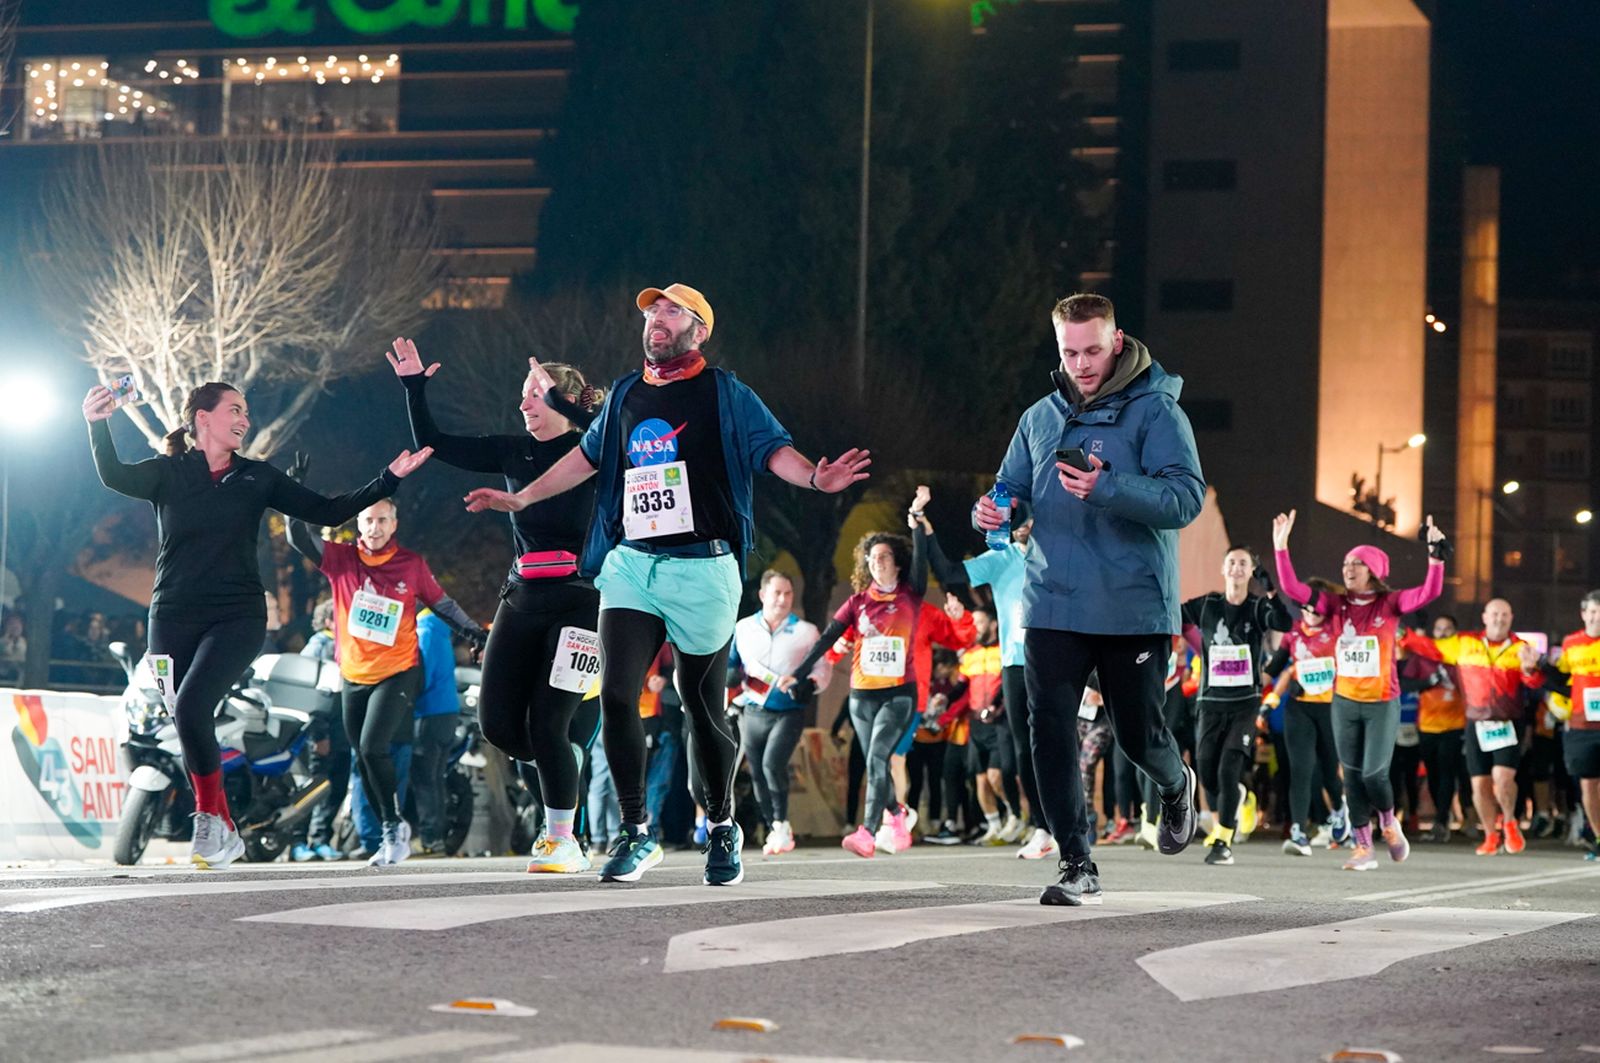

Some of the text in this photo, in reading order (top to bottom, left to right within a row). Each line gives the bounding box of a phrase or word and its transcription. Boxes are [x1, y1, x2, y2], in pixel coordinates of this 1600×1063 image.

[632, 439, 676, 453] NASA
[631, 489, 677, 515] 4333
[358, 609, 390, 628] 9281
[566, 641, 581, 649] SAN
[869, 651, 897, 663] 2494
[1345, 651, 1370, 663] 5487
[70, 736, 116, 775] SAN
[82, 782, 128, 819] ANT
